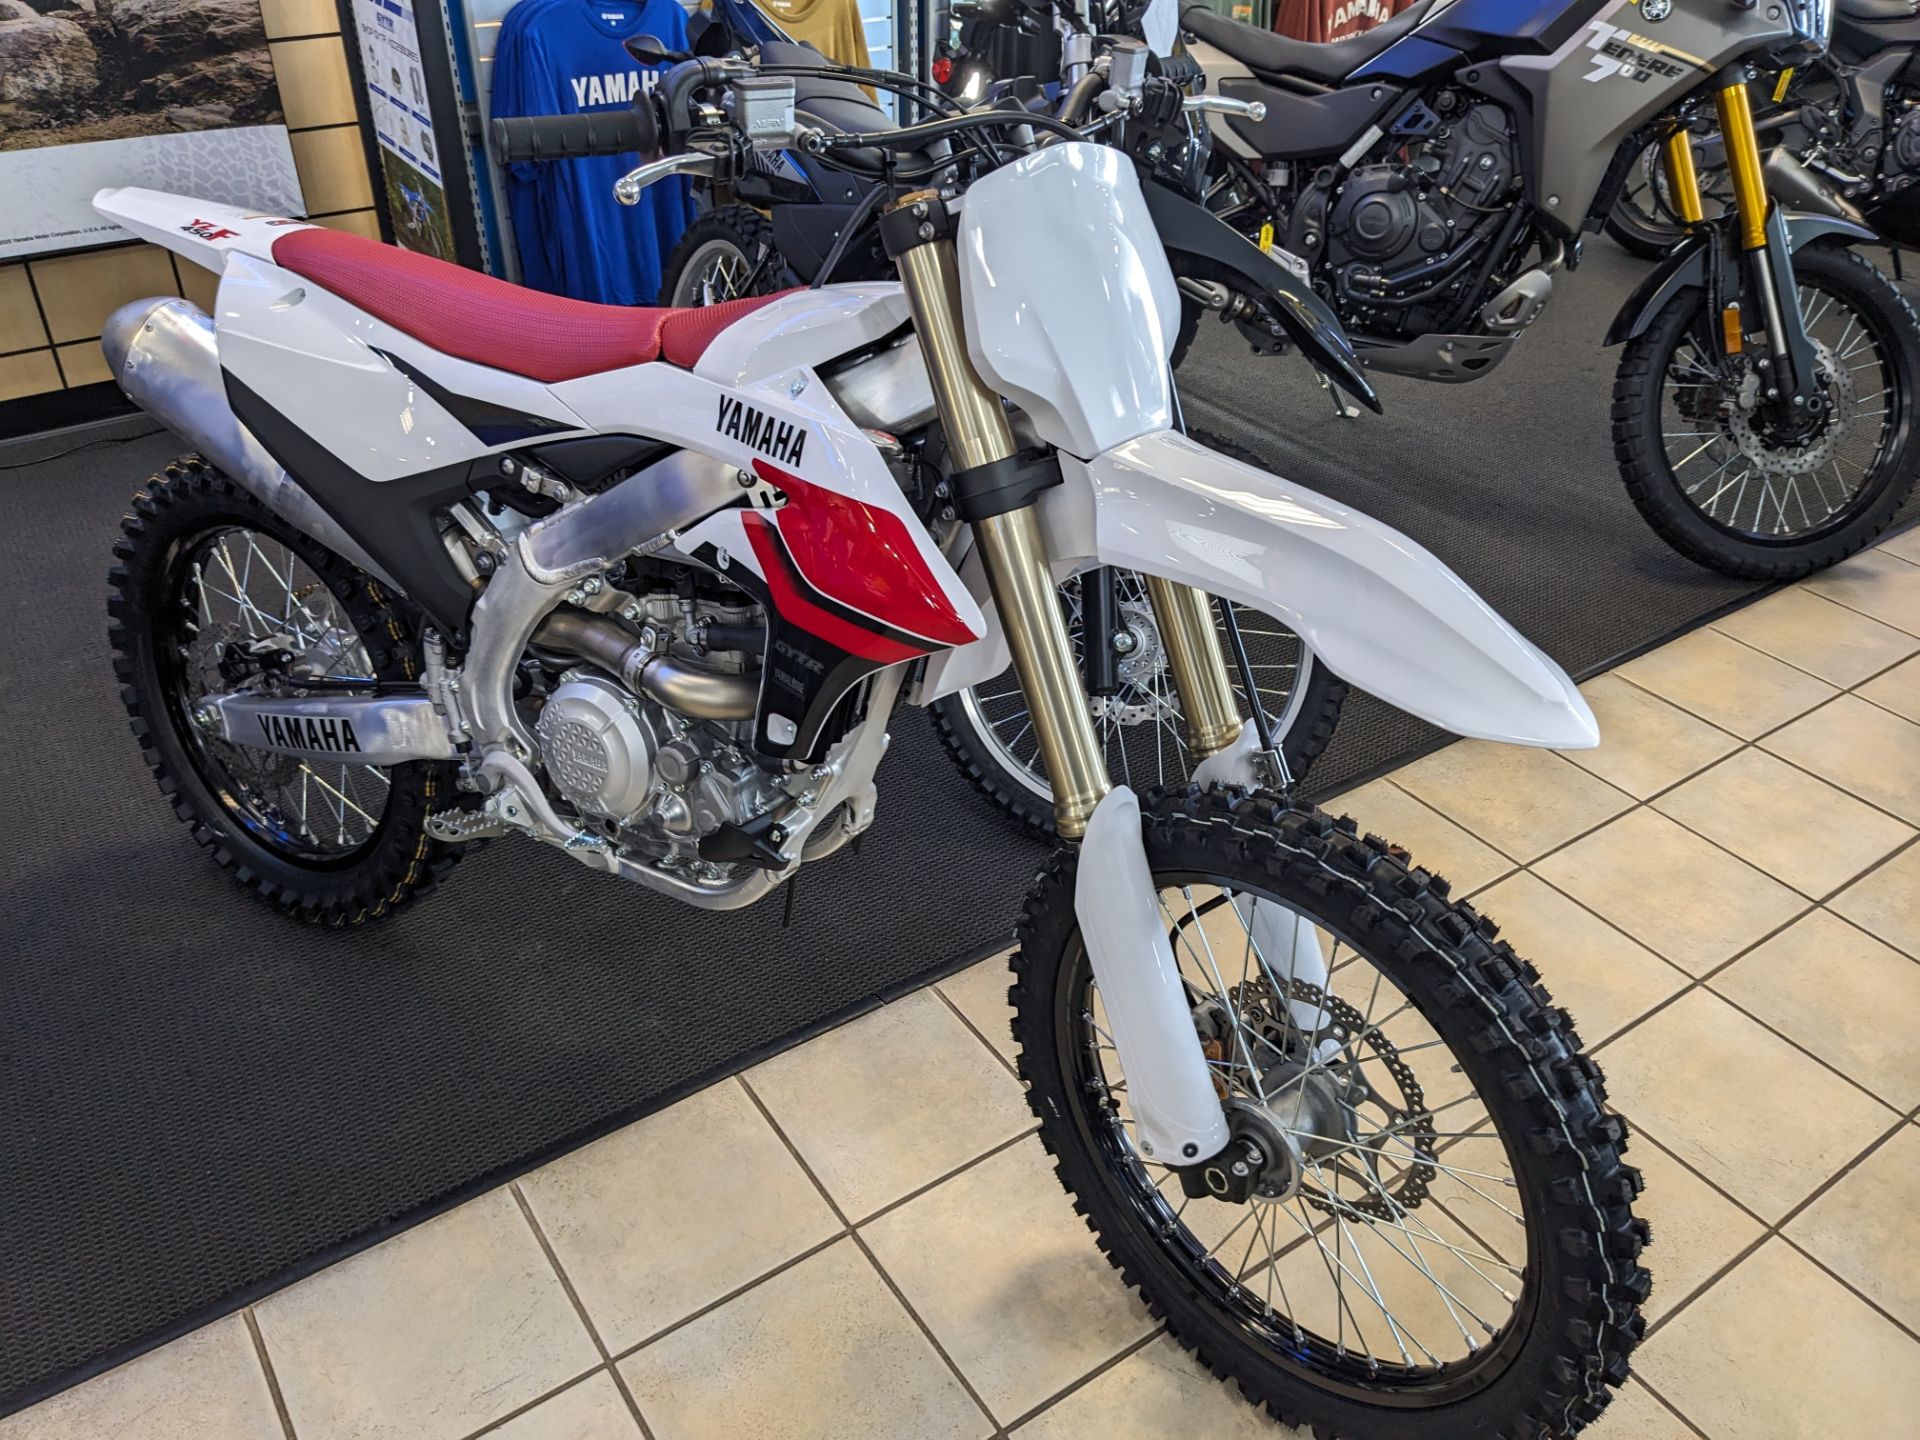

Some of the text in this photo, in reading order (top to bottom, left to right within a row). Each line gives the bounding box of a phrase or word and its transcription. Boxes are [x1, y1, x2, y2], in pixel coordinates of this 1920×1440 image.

[571, 69, 667, 107] YAMAH
[190, 218, 217, 231] YZ
[716, 393, 808, 469] YAMAHA
[256, 713, 362, 752] YAMAHA
